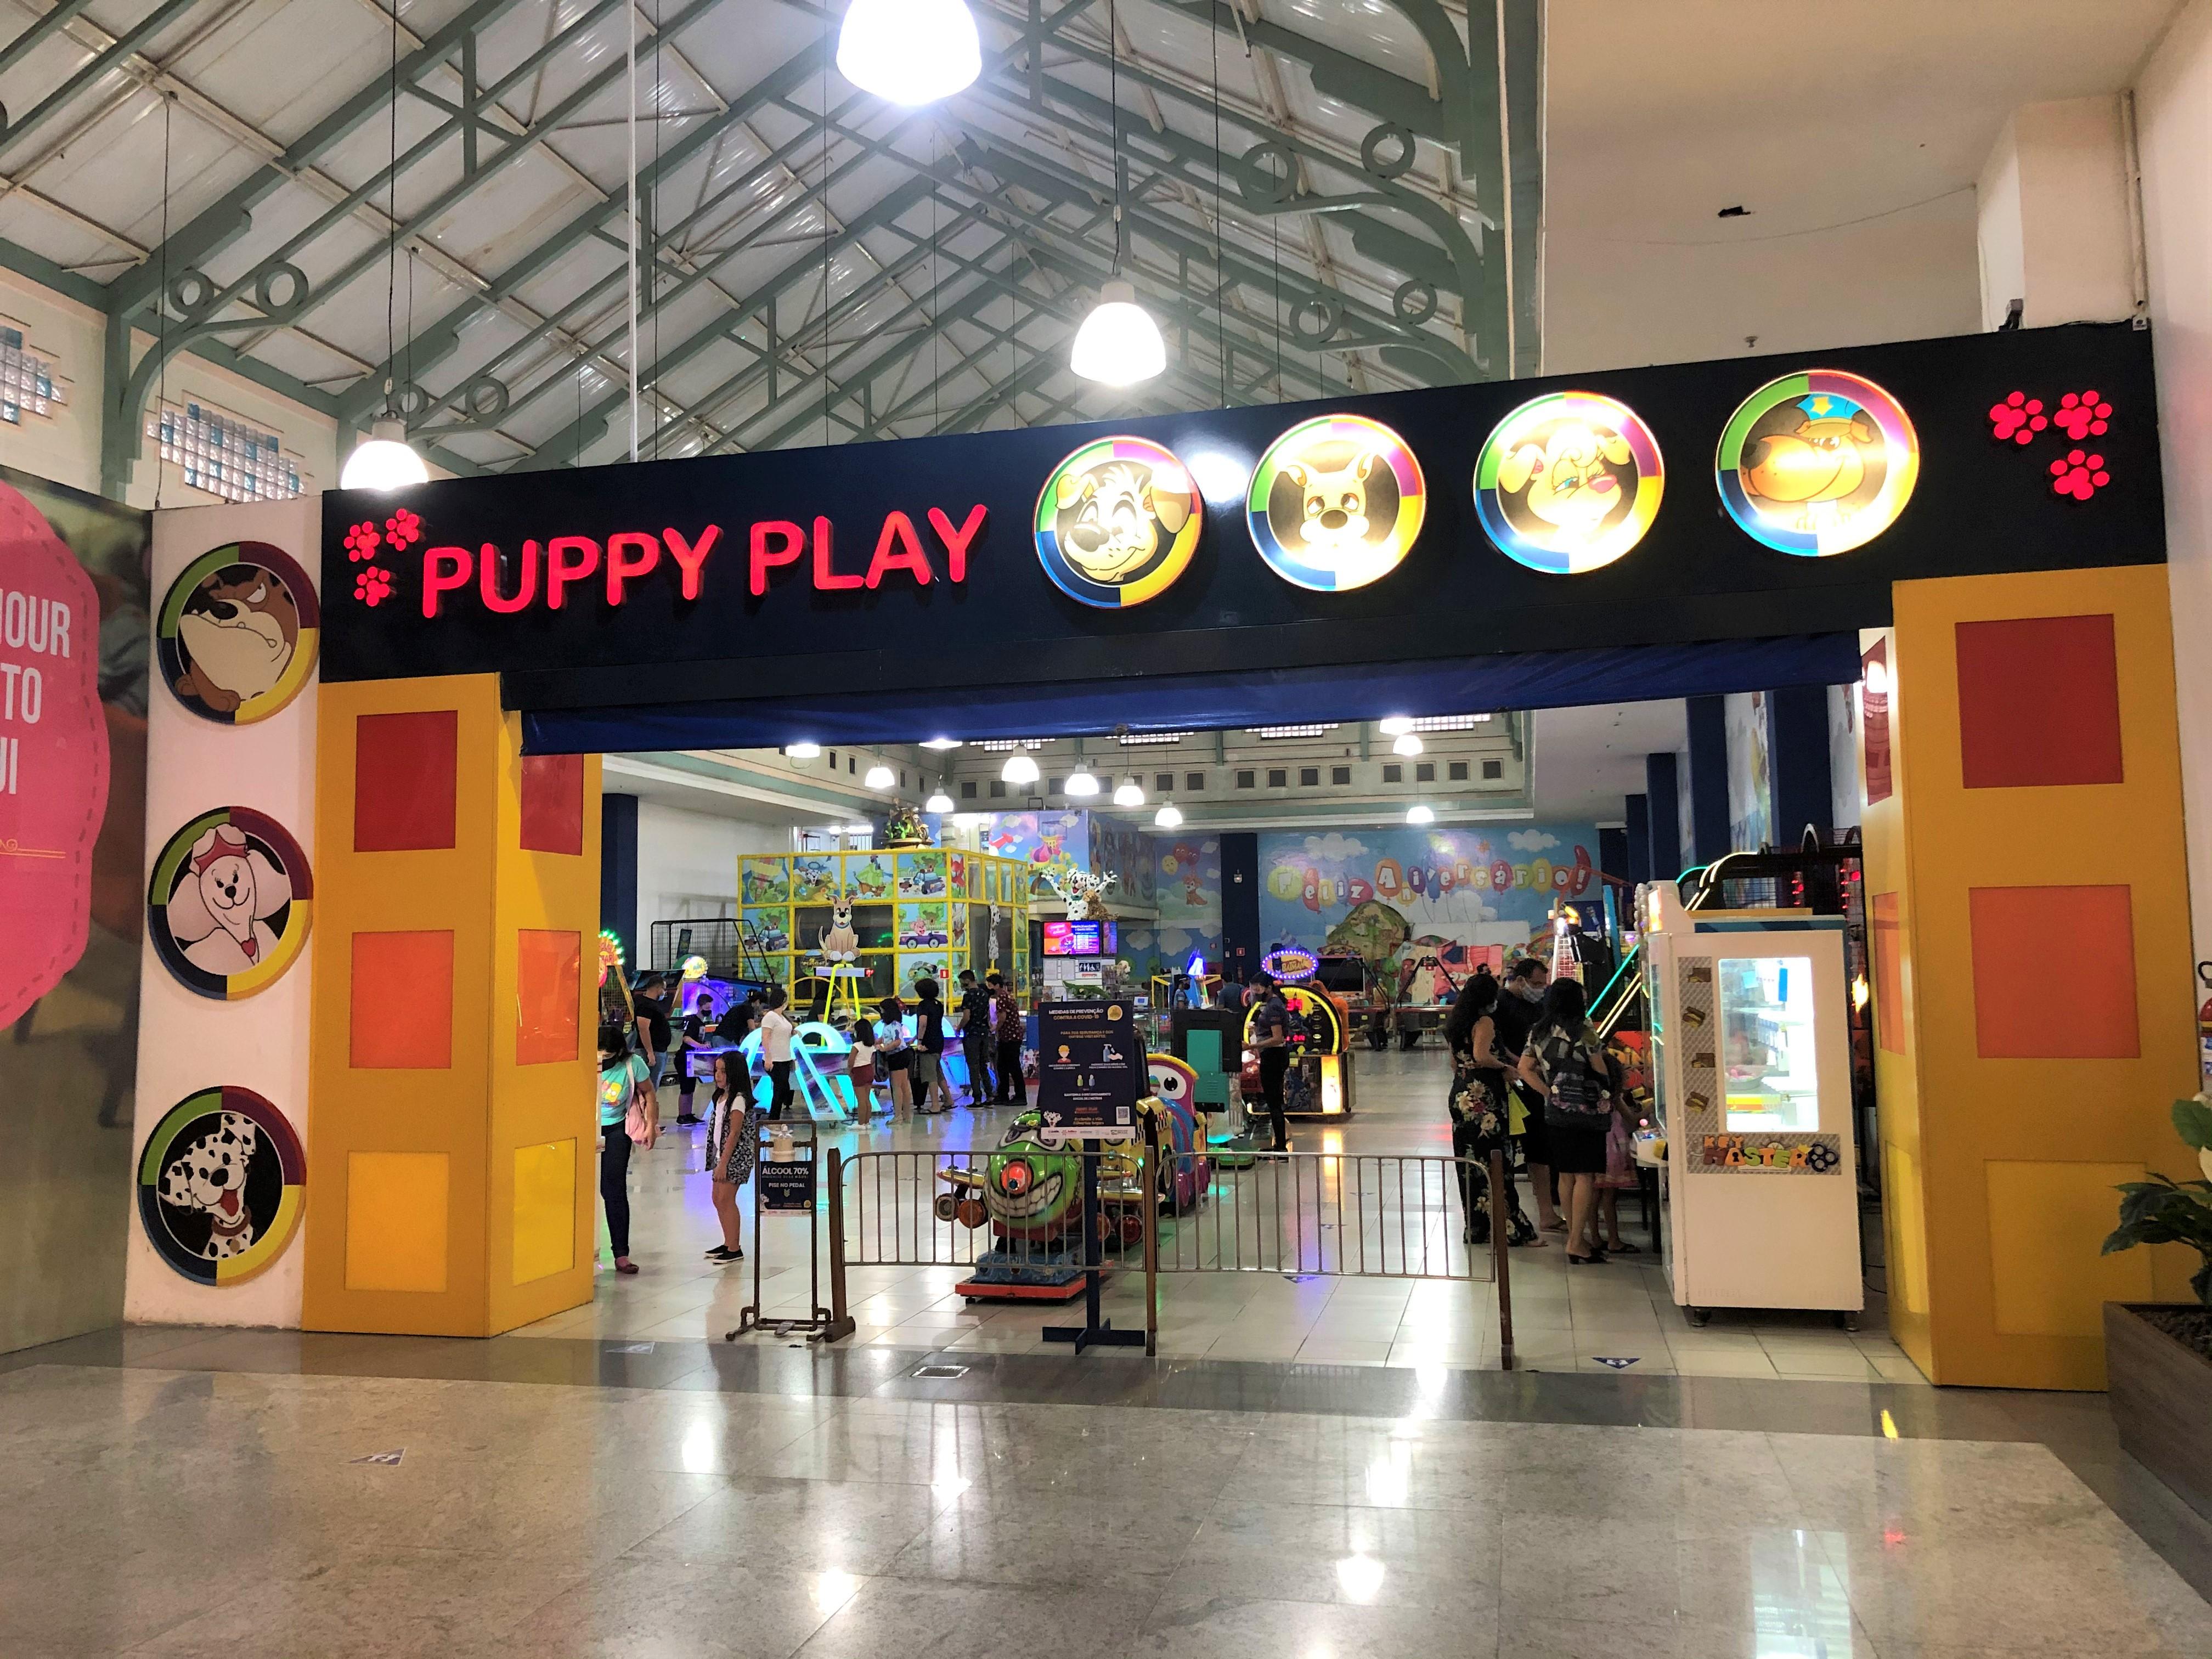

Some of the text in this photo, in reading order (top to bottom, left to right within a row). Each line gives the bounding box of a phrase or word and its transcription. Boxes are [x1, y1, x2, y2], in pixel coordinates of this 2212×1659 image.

[421, 503, 990, 619] PUPPY PLAY
[0, 588, 70, 658] OUR
[1278, 871, 1365, 900] Feliz
[1703, 1135, 1745, 1148] KEY
[762, 1165, 793, 1175] ÁLCOOL
[1703, 1146, 1808, 1169] MASTER
